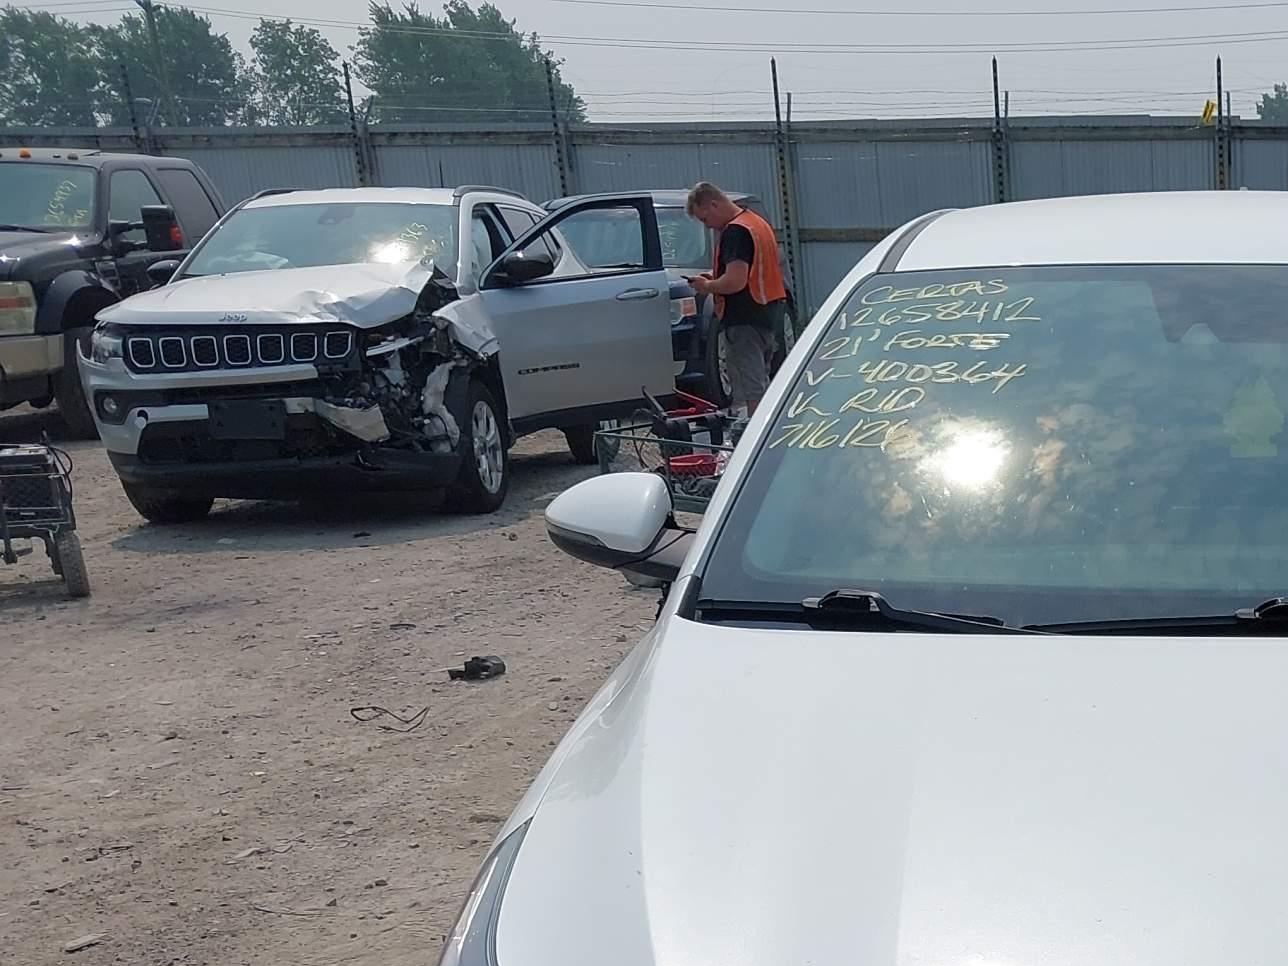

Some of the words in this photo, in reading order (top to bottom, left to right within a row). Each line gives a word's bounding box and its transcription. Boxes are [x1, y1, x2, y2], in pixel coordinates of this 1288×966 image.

[861, 279, 1009, 305] CERTAS
[218, 311, 248, 323] Jeep
[839, 296, 1042, 330] 12658412
[882, 329, 1010, 352] FORTE
